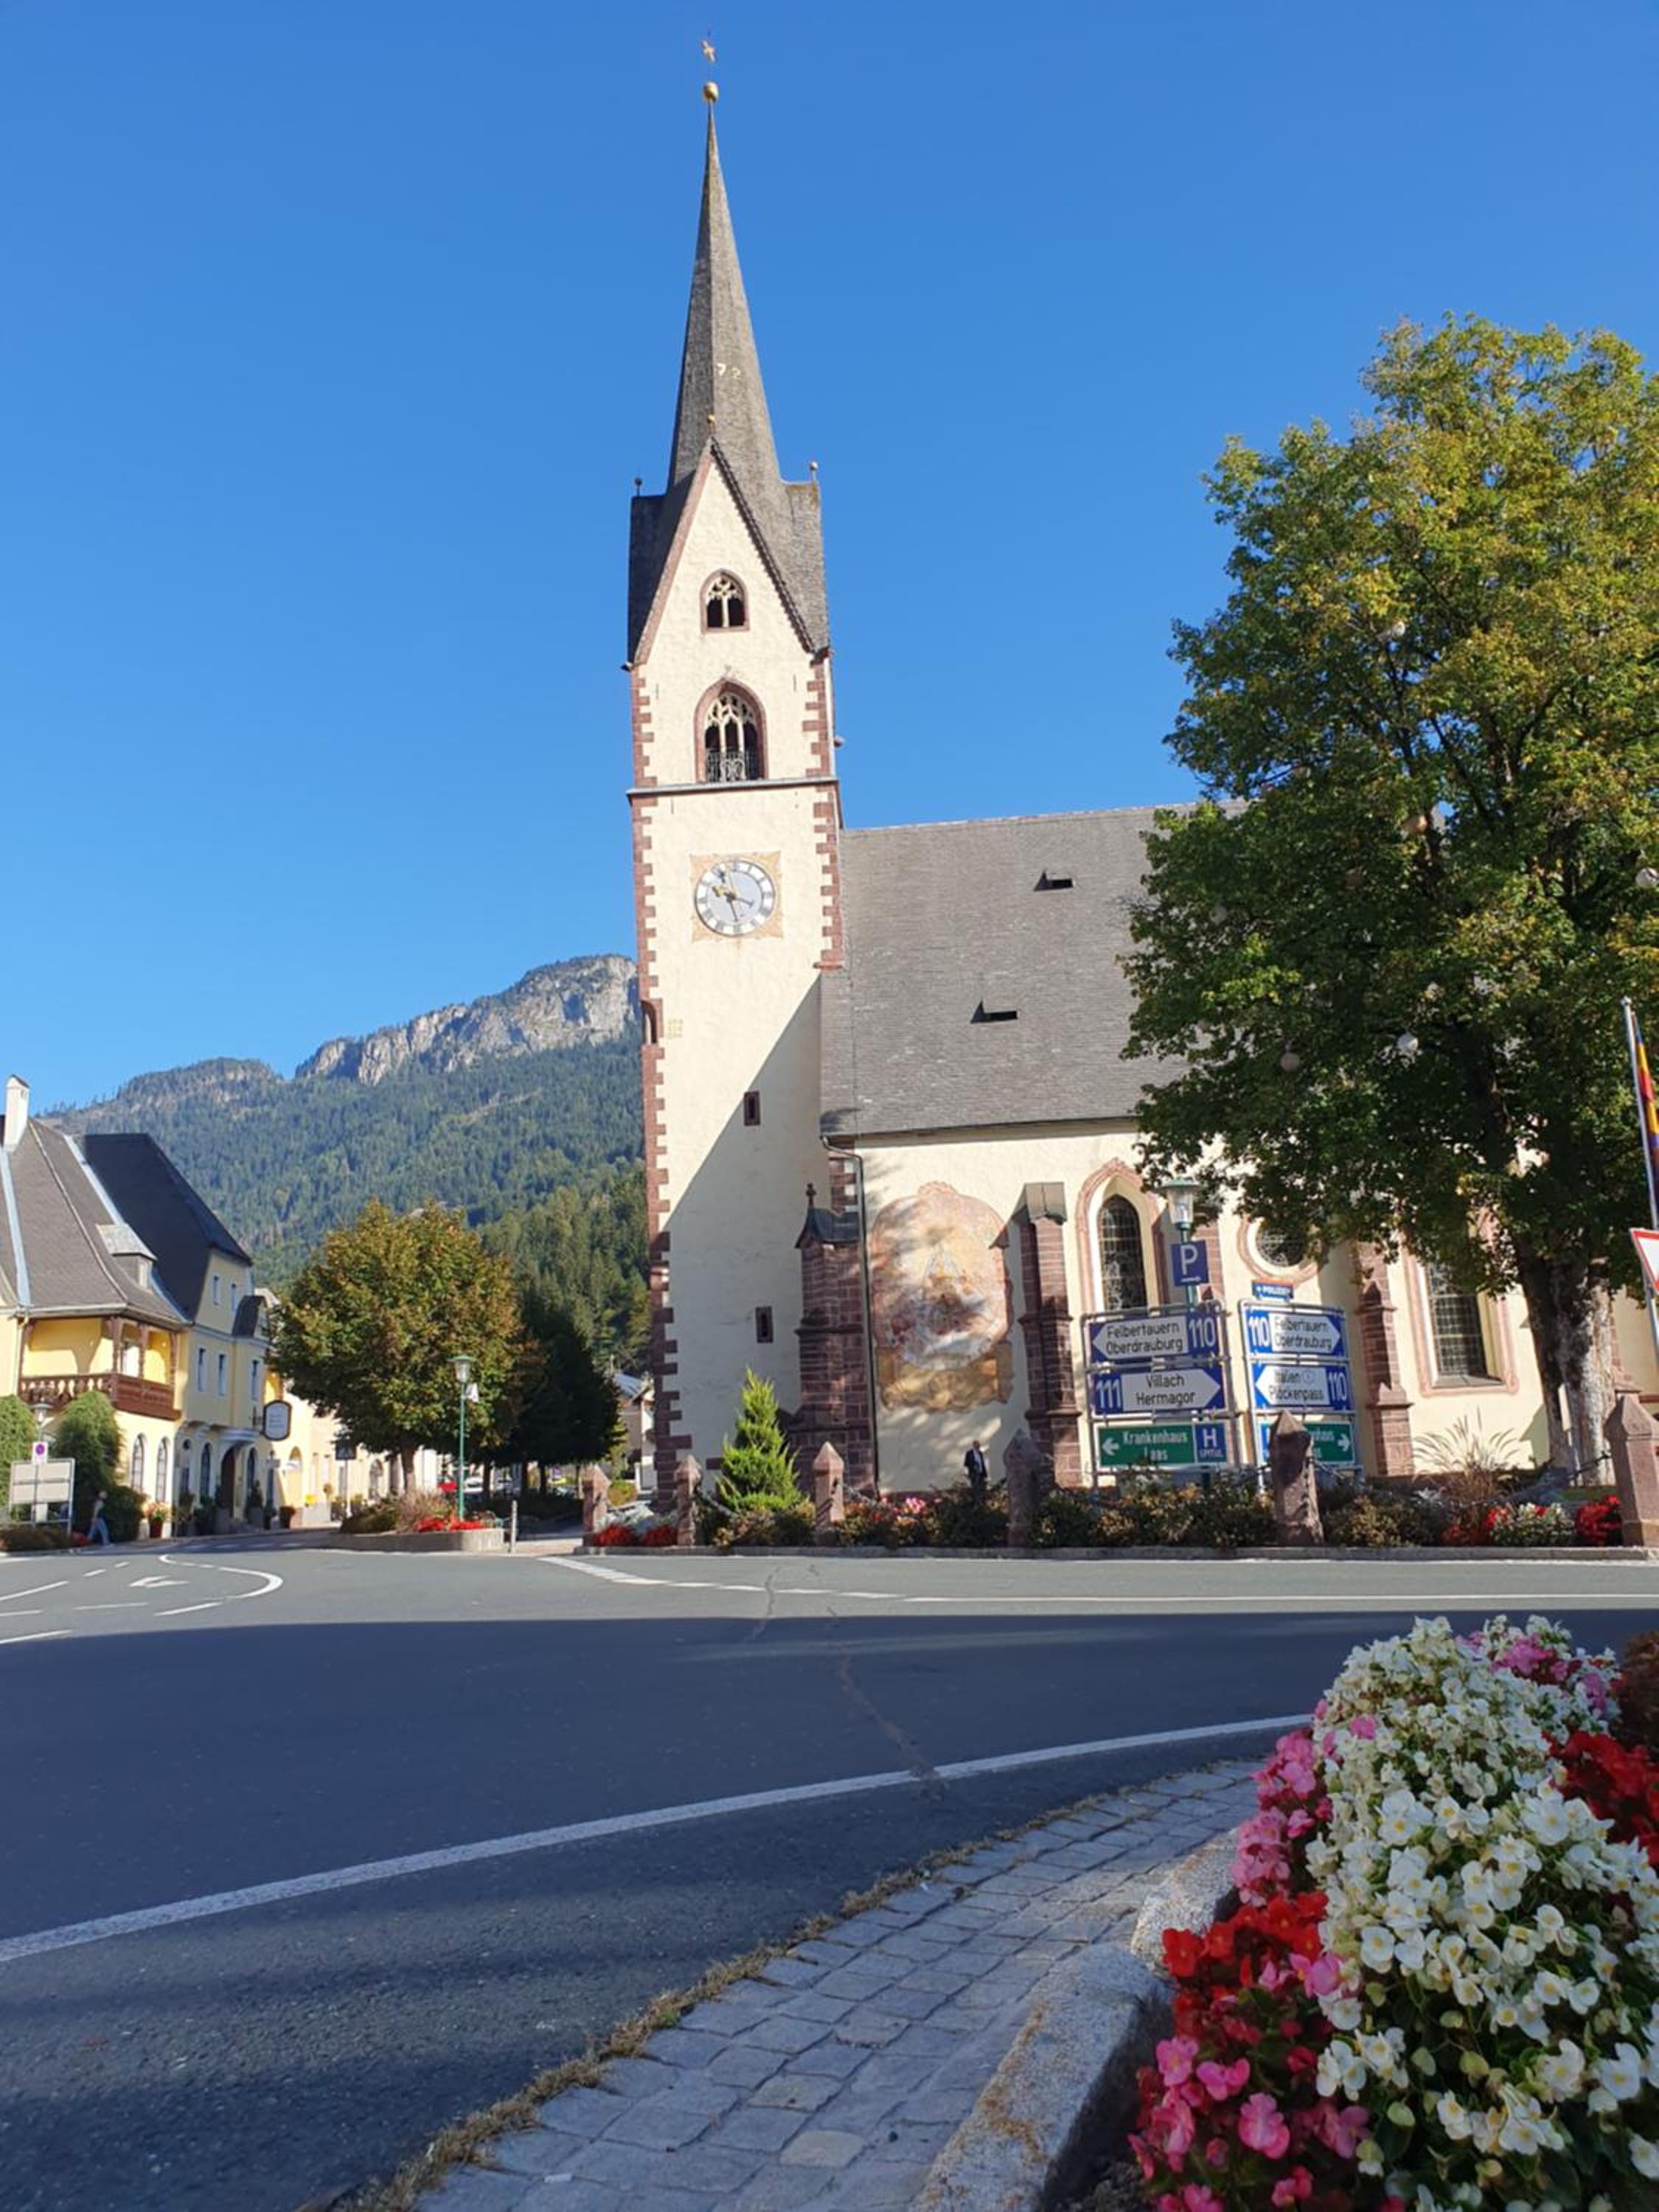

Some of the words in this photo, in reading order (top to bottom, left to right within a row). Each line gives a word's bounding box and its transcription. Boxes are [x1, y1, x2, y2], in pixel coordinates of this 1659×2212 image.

[1180, 1245, 1198, 1275] P
[1107, 1322, 1180, 1338] Felbertauern
[1189, 1317, 1217, 1348] 110
[1248, 1316, 1270, 1347] 110
[1107, 1338, 1183, 1355] Oberdrauburg
[1146, 1374, 1185, 1388] Villach
[1328, 1372, 1348, 1401] 110
[1096, 1379, 1121, 1409] 111
[1135, 1391, 1196, 1407] Hermagor
[1123, 1430, 1189, 1444] Krankenhaus
[1203, 1428, 1217, 1448] H
